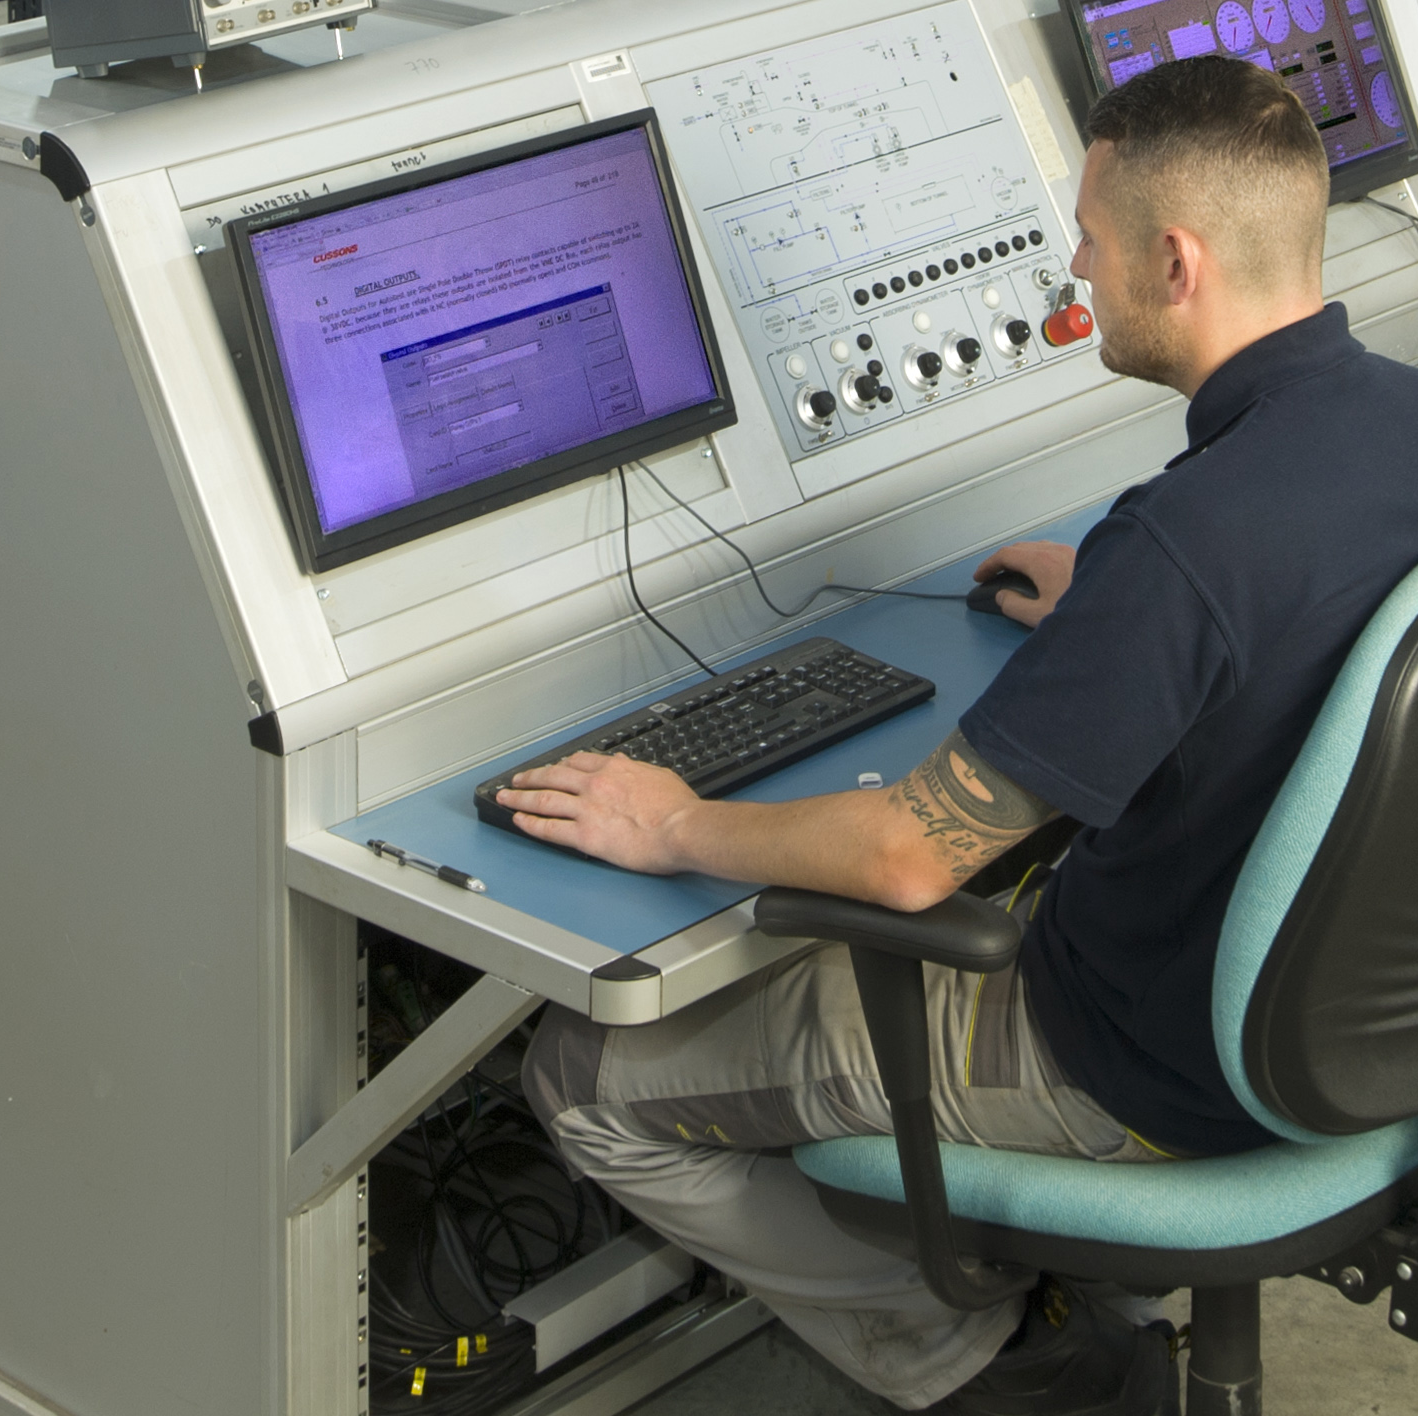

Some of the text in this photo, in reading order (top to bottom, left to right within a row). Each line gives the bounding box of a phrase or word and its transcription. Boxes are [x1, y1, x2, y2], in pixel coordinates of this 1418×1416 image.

[574, 177, 590, 190] Page
[312, 243, 359, 264] CUSSONS
[931, 242, 951, 252] VALVES
[1028, 253, 1053, 266] CONTROL
[353, 279, 382, 296] DIGITAL
[966, 274, 1004, 292] DYNAMOMETER
[314, 296, 328, 307] 6.5
[318, 309, 340, 324] Digital
[340, 302, 367, 318] Outputs
[417, 281, 437, 295] Single
[354, 309, 381, 324] because
[382, 304, 397, 317] they
[410, 294, 431, 308] relays
[449, 281, 474, 296] outputs
[882, 290, 948, 318] ABSORBING DYNAMOMETER
[828, 324, 851, 336] VACUUM
[774, 341, 801, 355] IMPELLER
